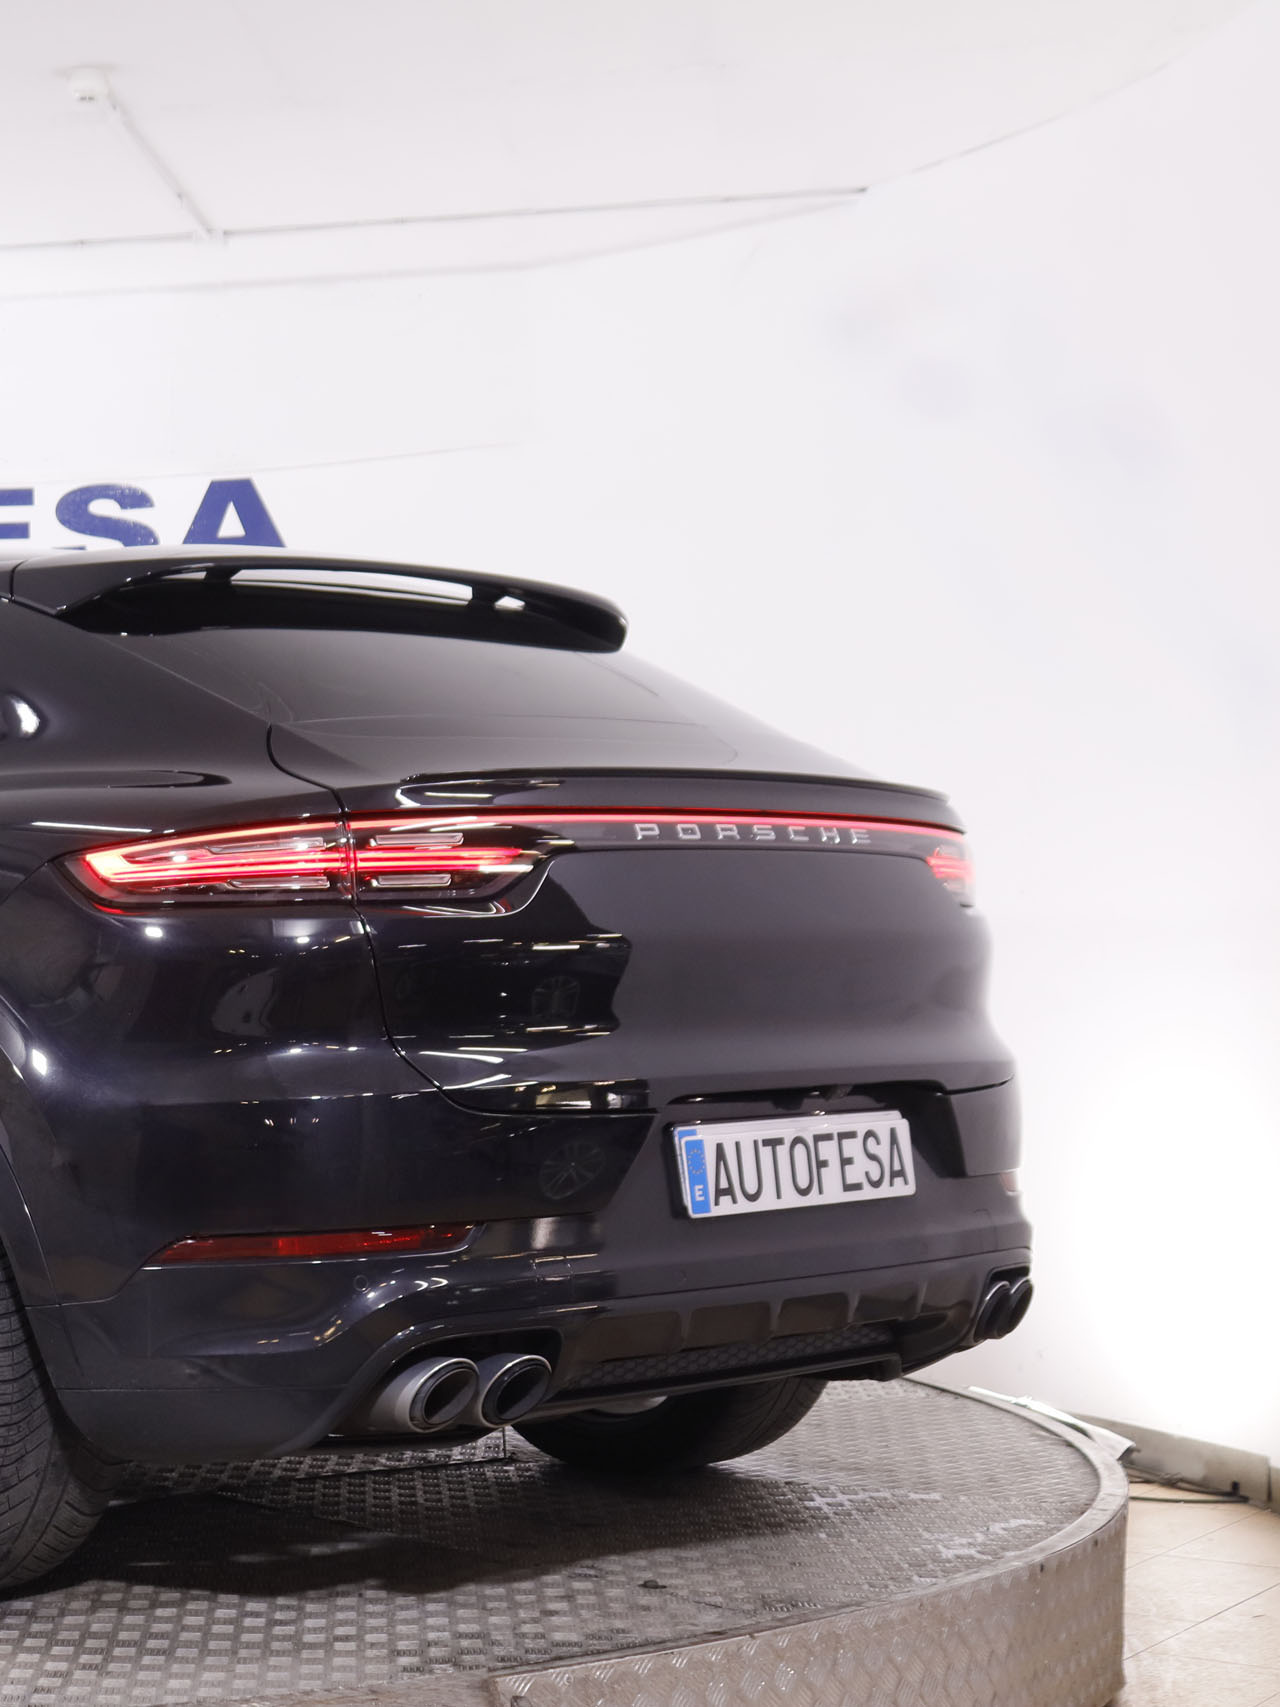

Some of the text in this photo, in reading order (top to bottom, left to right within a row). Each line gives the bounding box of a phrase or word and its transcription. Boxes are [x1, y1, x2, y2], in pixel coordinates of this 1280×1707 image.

[634, 823, 872, 844] PORSCHE
[714, 1127, 910, 1207] AUTOFESA
[694, 1184, 705, 1202] E
